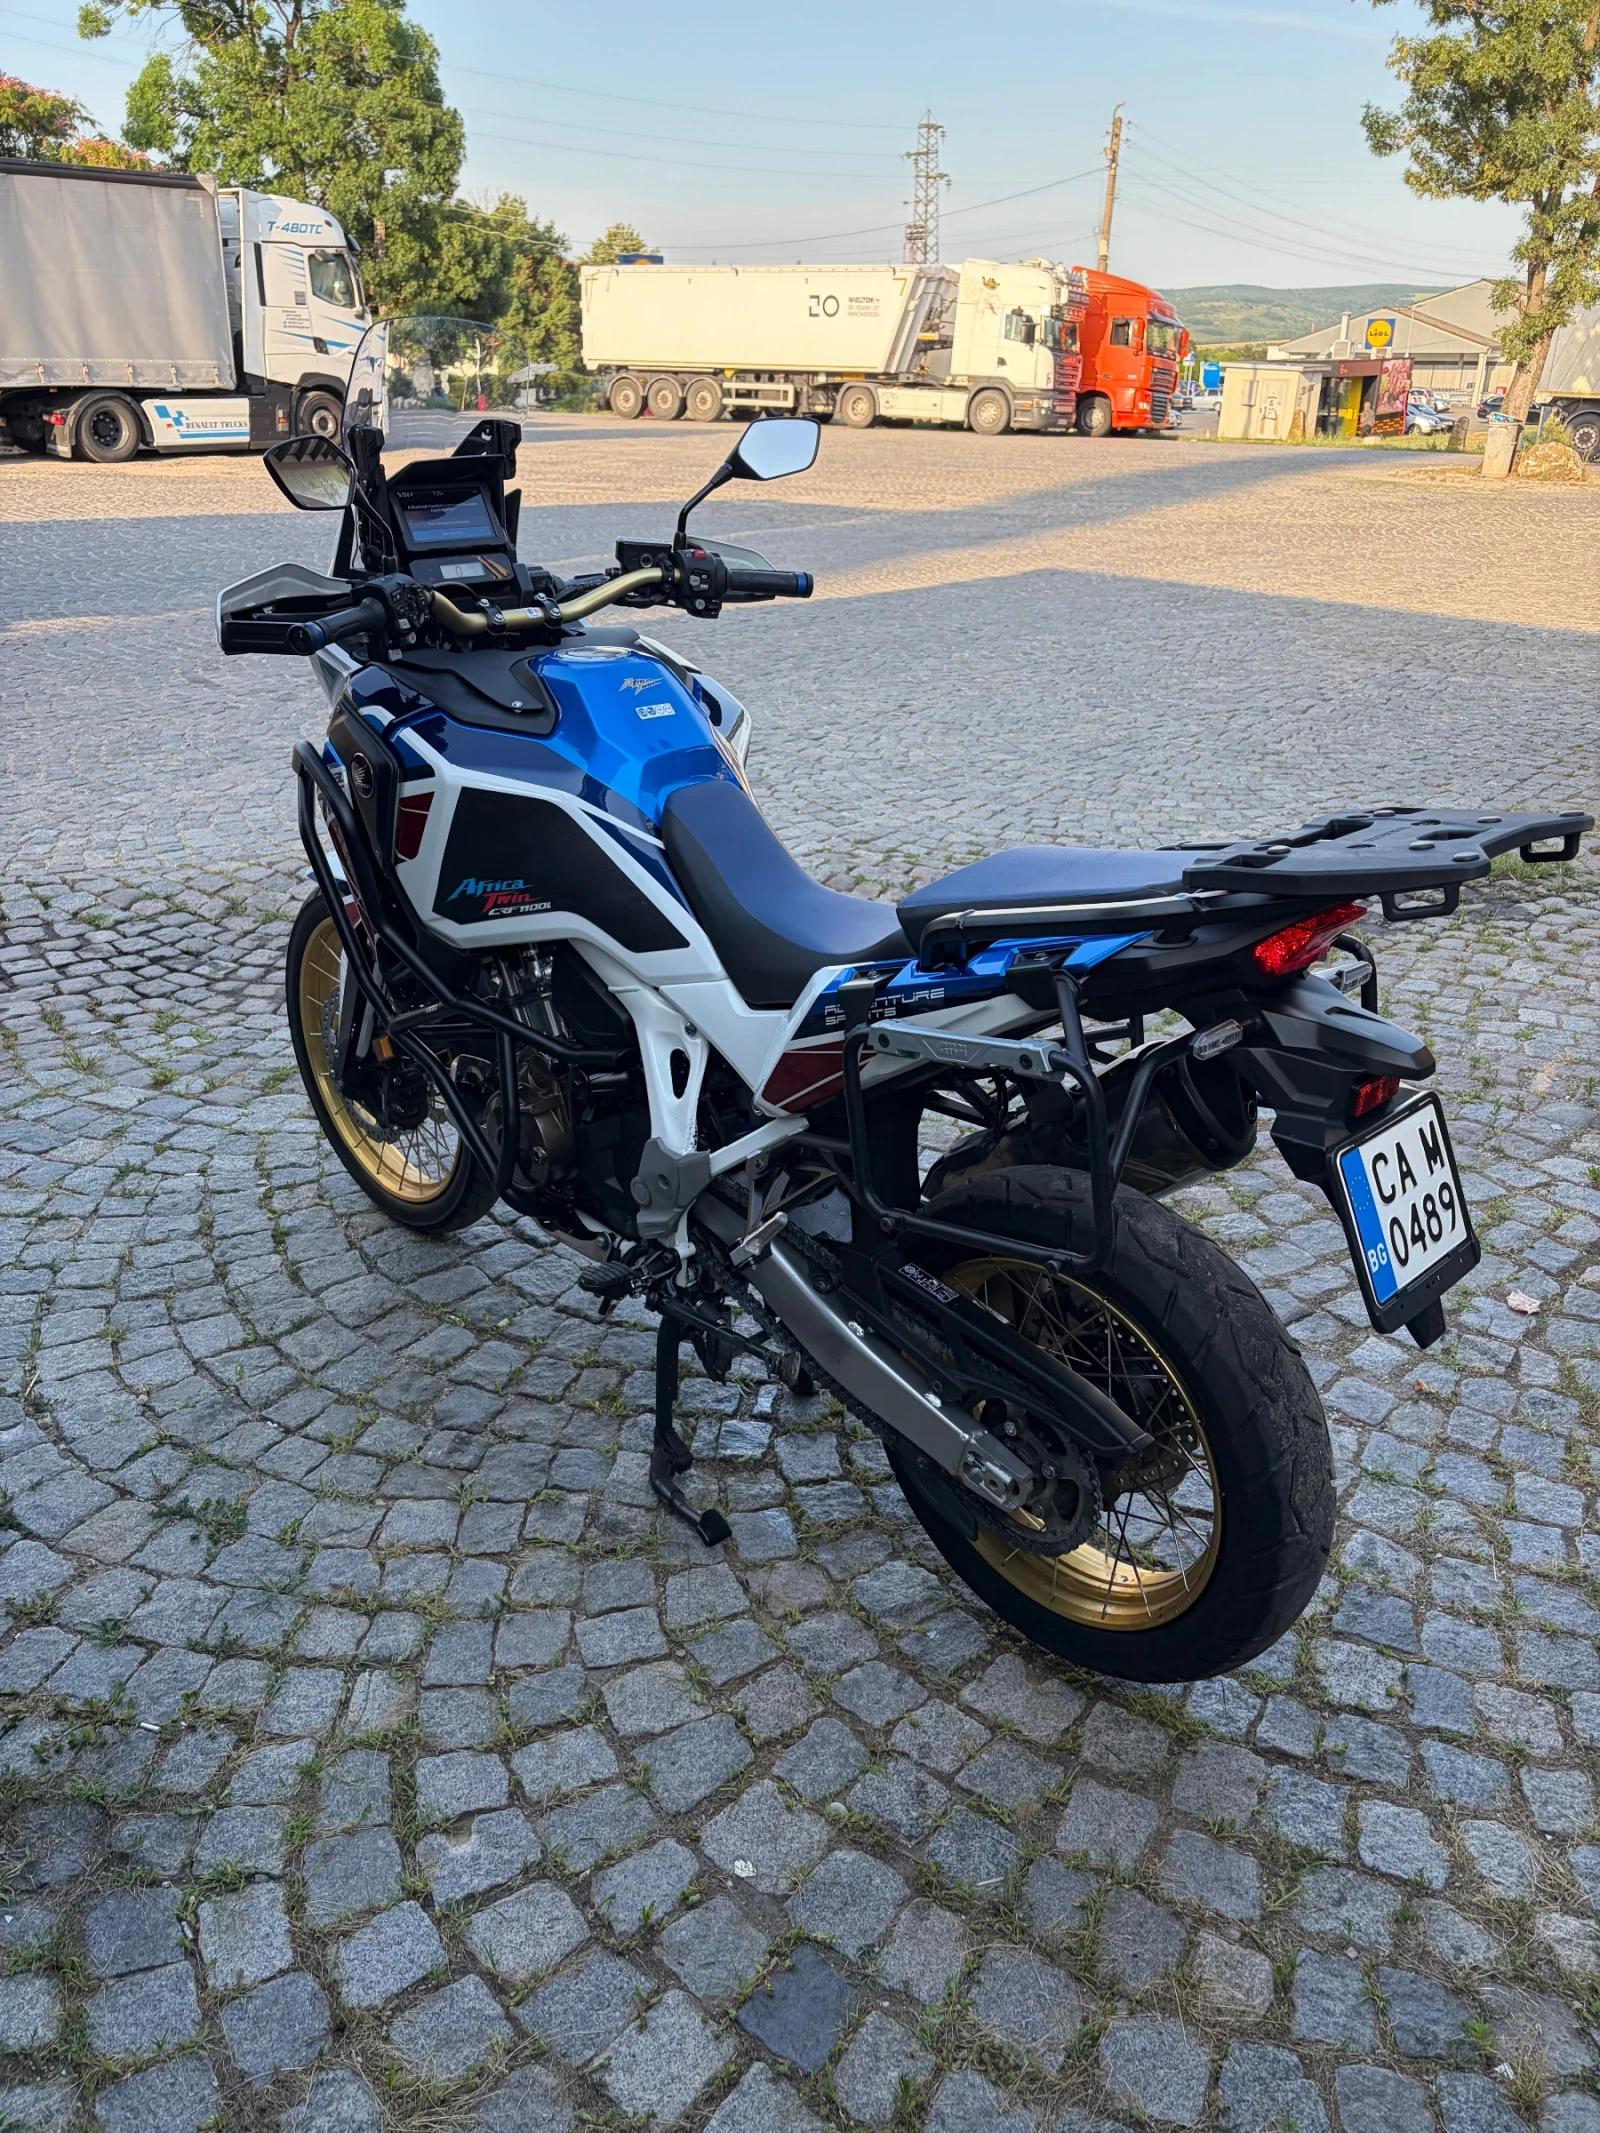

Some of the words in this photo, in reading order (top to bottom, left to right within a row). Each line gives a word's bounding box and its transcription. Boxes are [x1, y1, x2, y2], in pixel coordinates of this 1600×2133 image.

[185, 421, 218, 429] RENAULT
[220, 420, 248, 428] TRUCKS
[446, 878, 535, 902] Africa
[482, 891, 542, 914] Twin
[1371, 1141, 1418, 1205] CA
[1418, 1120, 1445, 1176] M
[1389, 1181, 1456, 1267] 0489
[1367, 1242, 1388, 1273] BG
